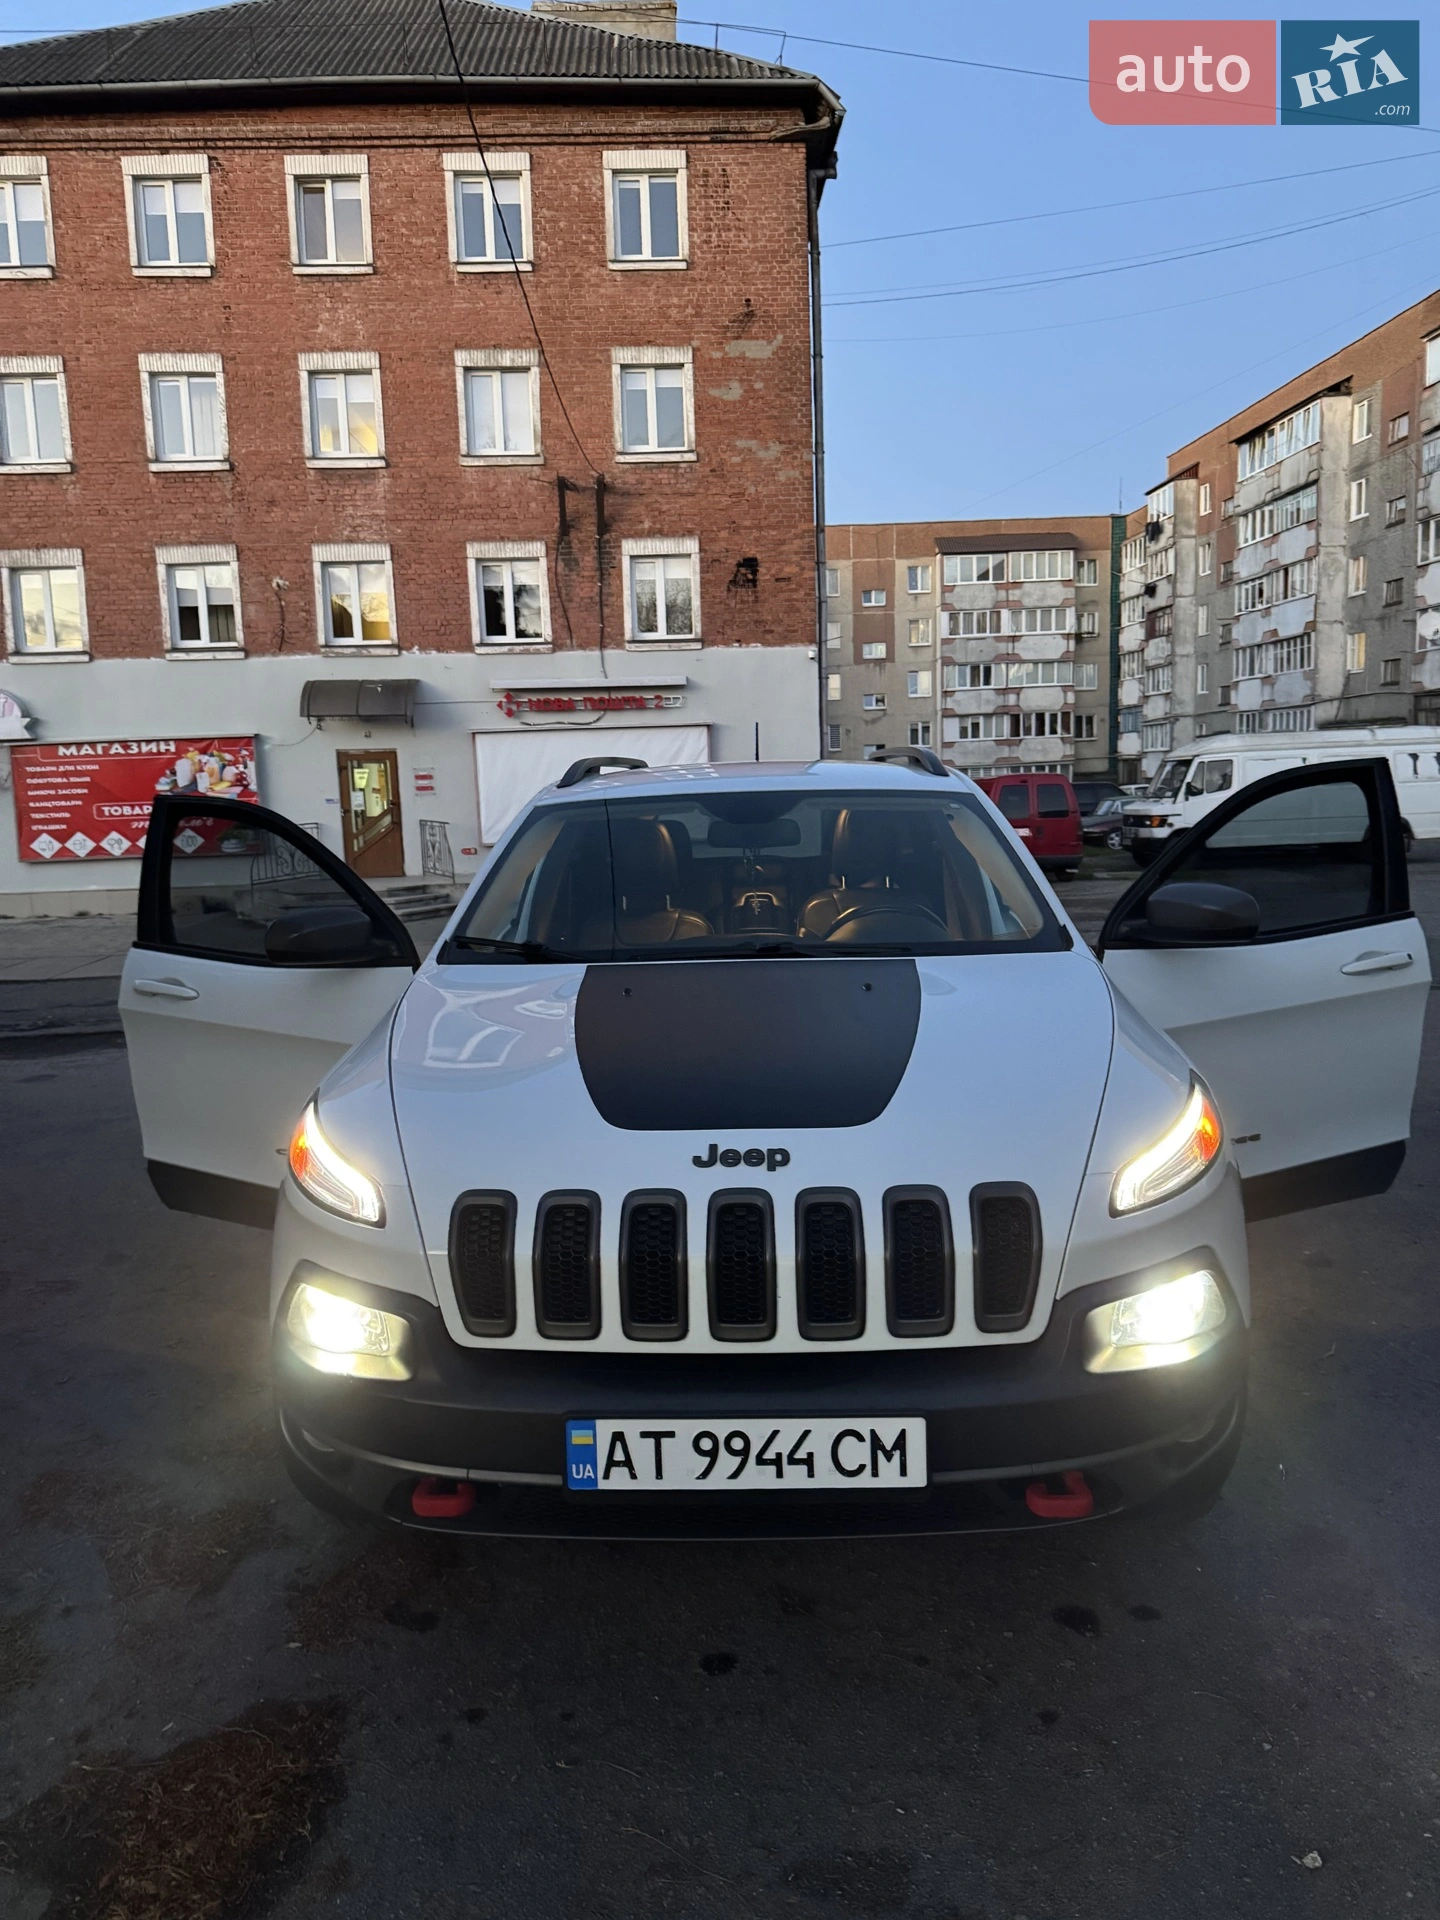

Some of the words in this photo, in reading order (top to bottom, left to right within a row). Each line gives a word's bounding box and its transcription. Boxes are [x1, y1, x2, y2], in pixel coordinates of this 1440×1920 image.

[527, 696, 577, 711] НОВА
[583, 695, 648, 711] ПОШТА
[57, 741, 177, 757] МАГАЗИН
[101, 805, 153, 817] ТОВАР
[692, 1143, 791, 1172] Jeep
[602, 1430, 677, 1480] AT
[692, 1429, 816, 1480] 9944
[830, 1428, 908, 1479] CM
[571, 1464, 596, 1480] UA
